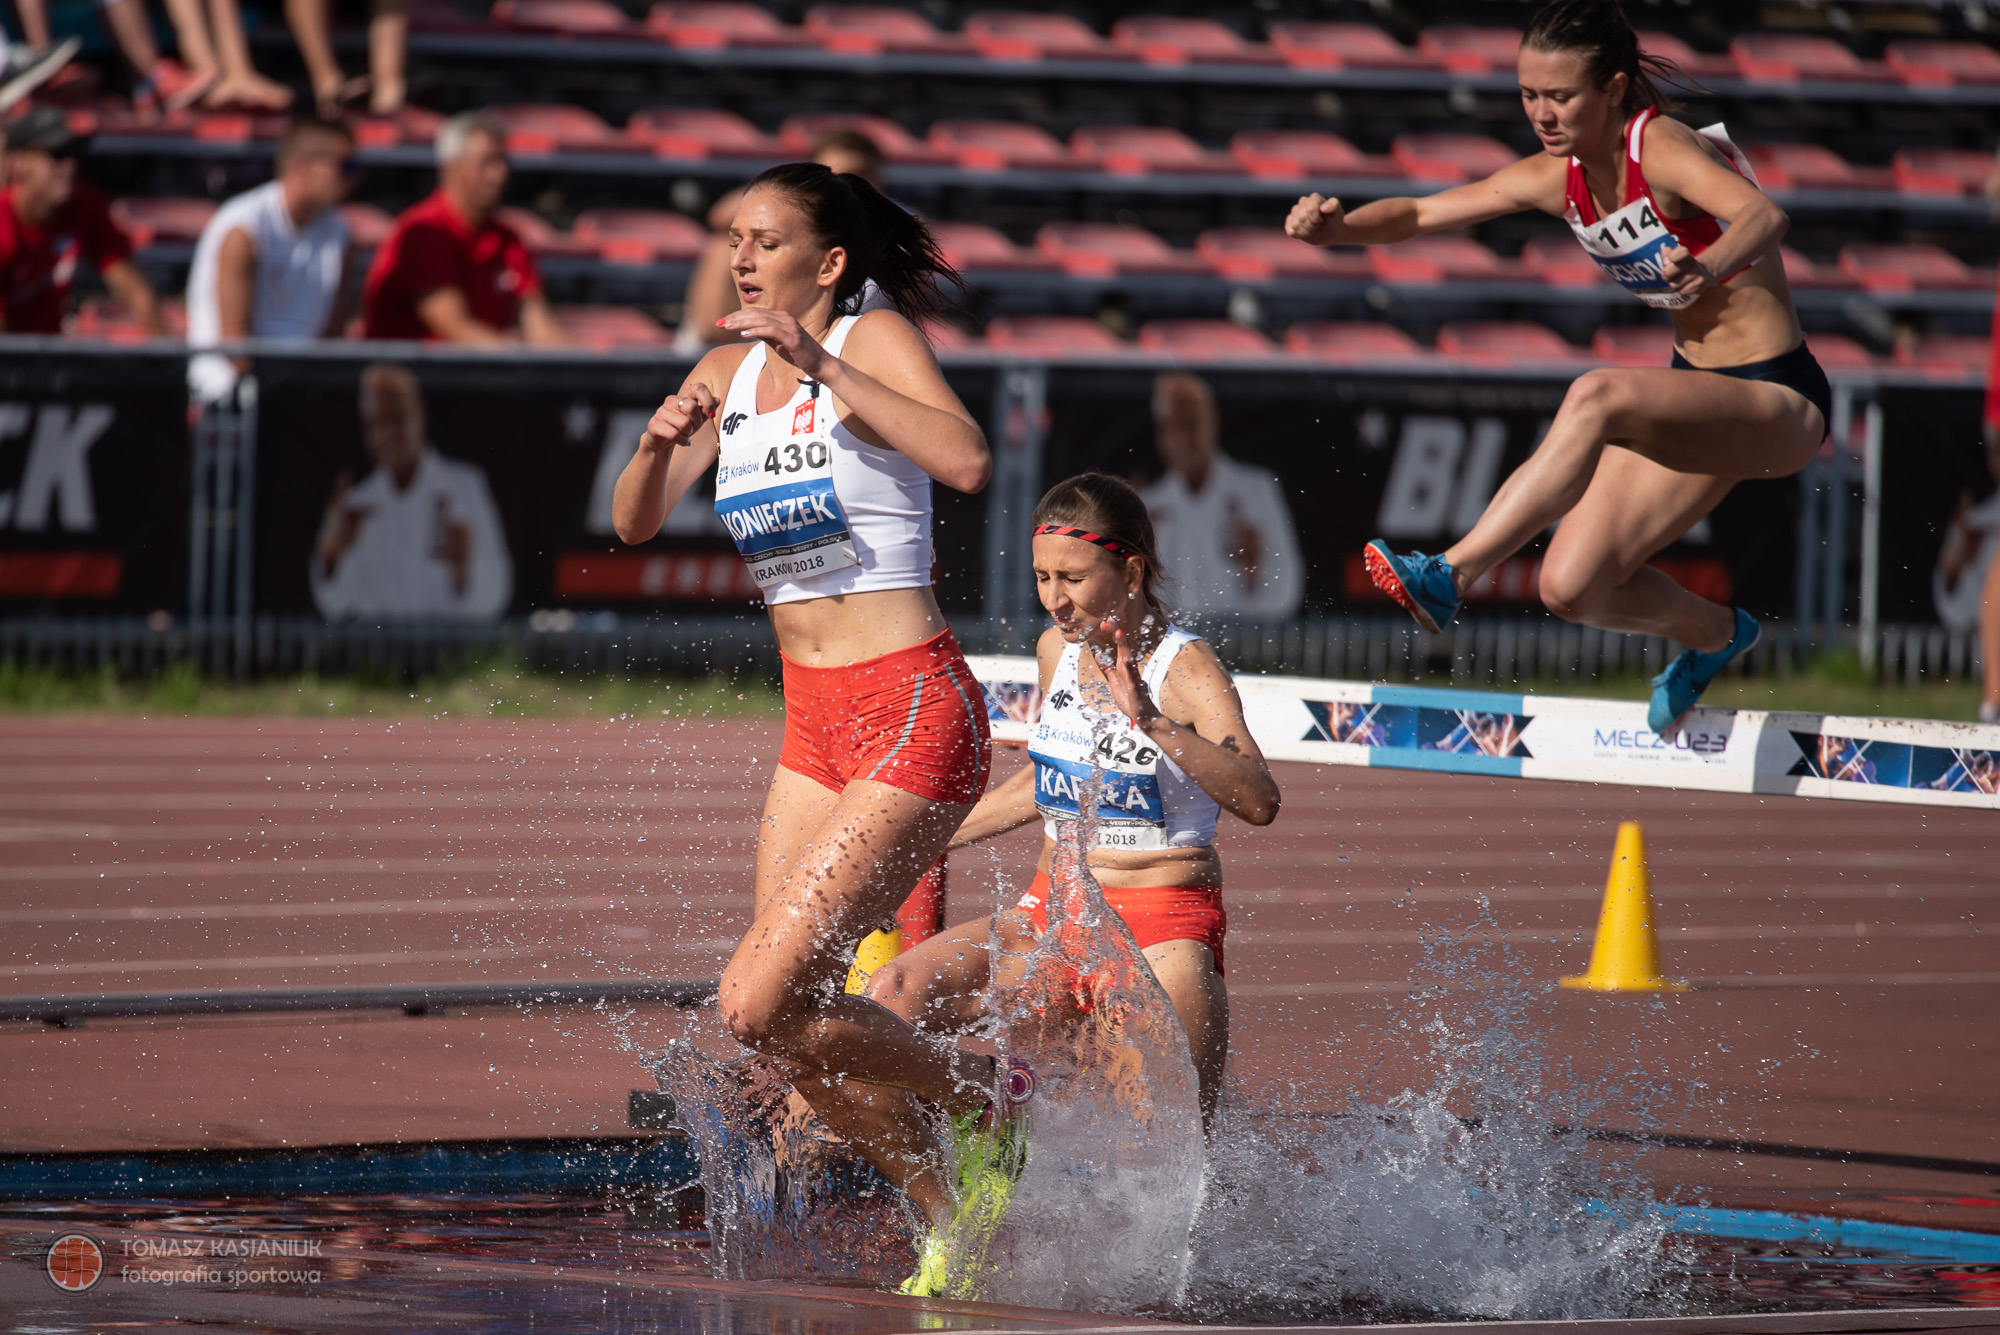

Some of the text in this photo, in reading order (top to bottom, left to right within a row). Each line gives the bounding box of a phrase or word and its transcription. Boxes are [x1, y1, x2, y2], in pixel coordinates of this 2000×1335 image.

[1598, 205, 1660, 249] 114
[730, 461, 760, 479] Kraków
[764, 441, 827, 476] 430
[721, 493, 836, 541] KONIECZEK
[754, 560, 793, 582] KRAKÓW
[794, 555, 824, 573] 2018
[1051, 728, 1094, 747] Kraków
[1098, 732, 1158, 765] 426
[1594, 728, 1727, 753] MECZ U23
[1041, 763, 1150, 810] KAPŁA
[1105, 833, 1136, 845] 2018
